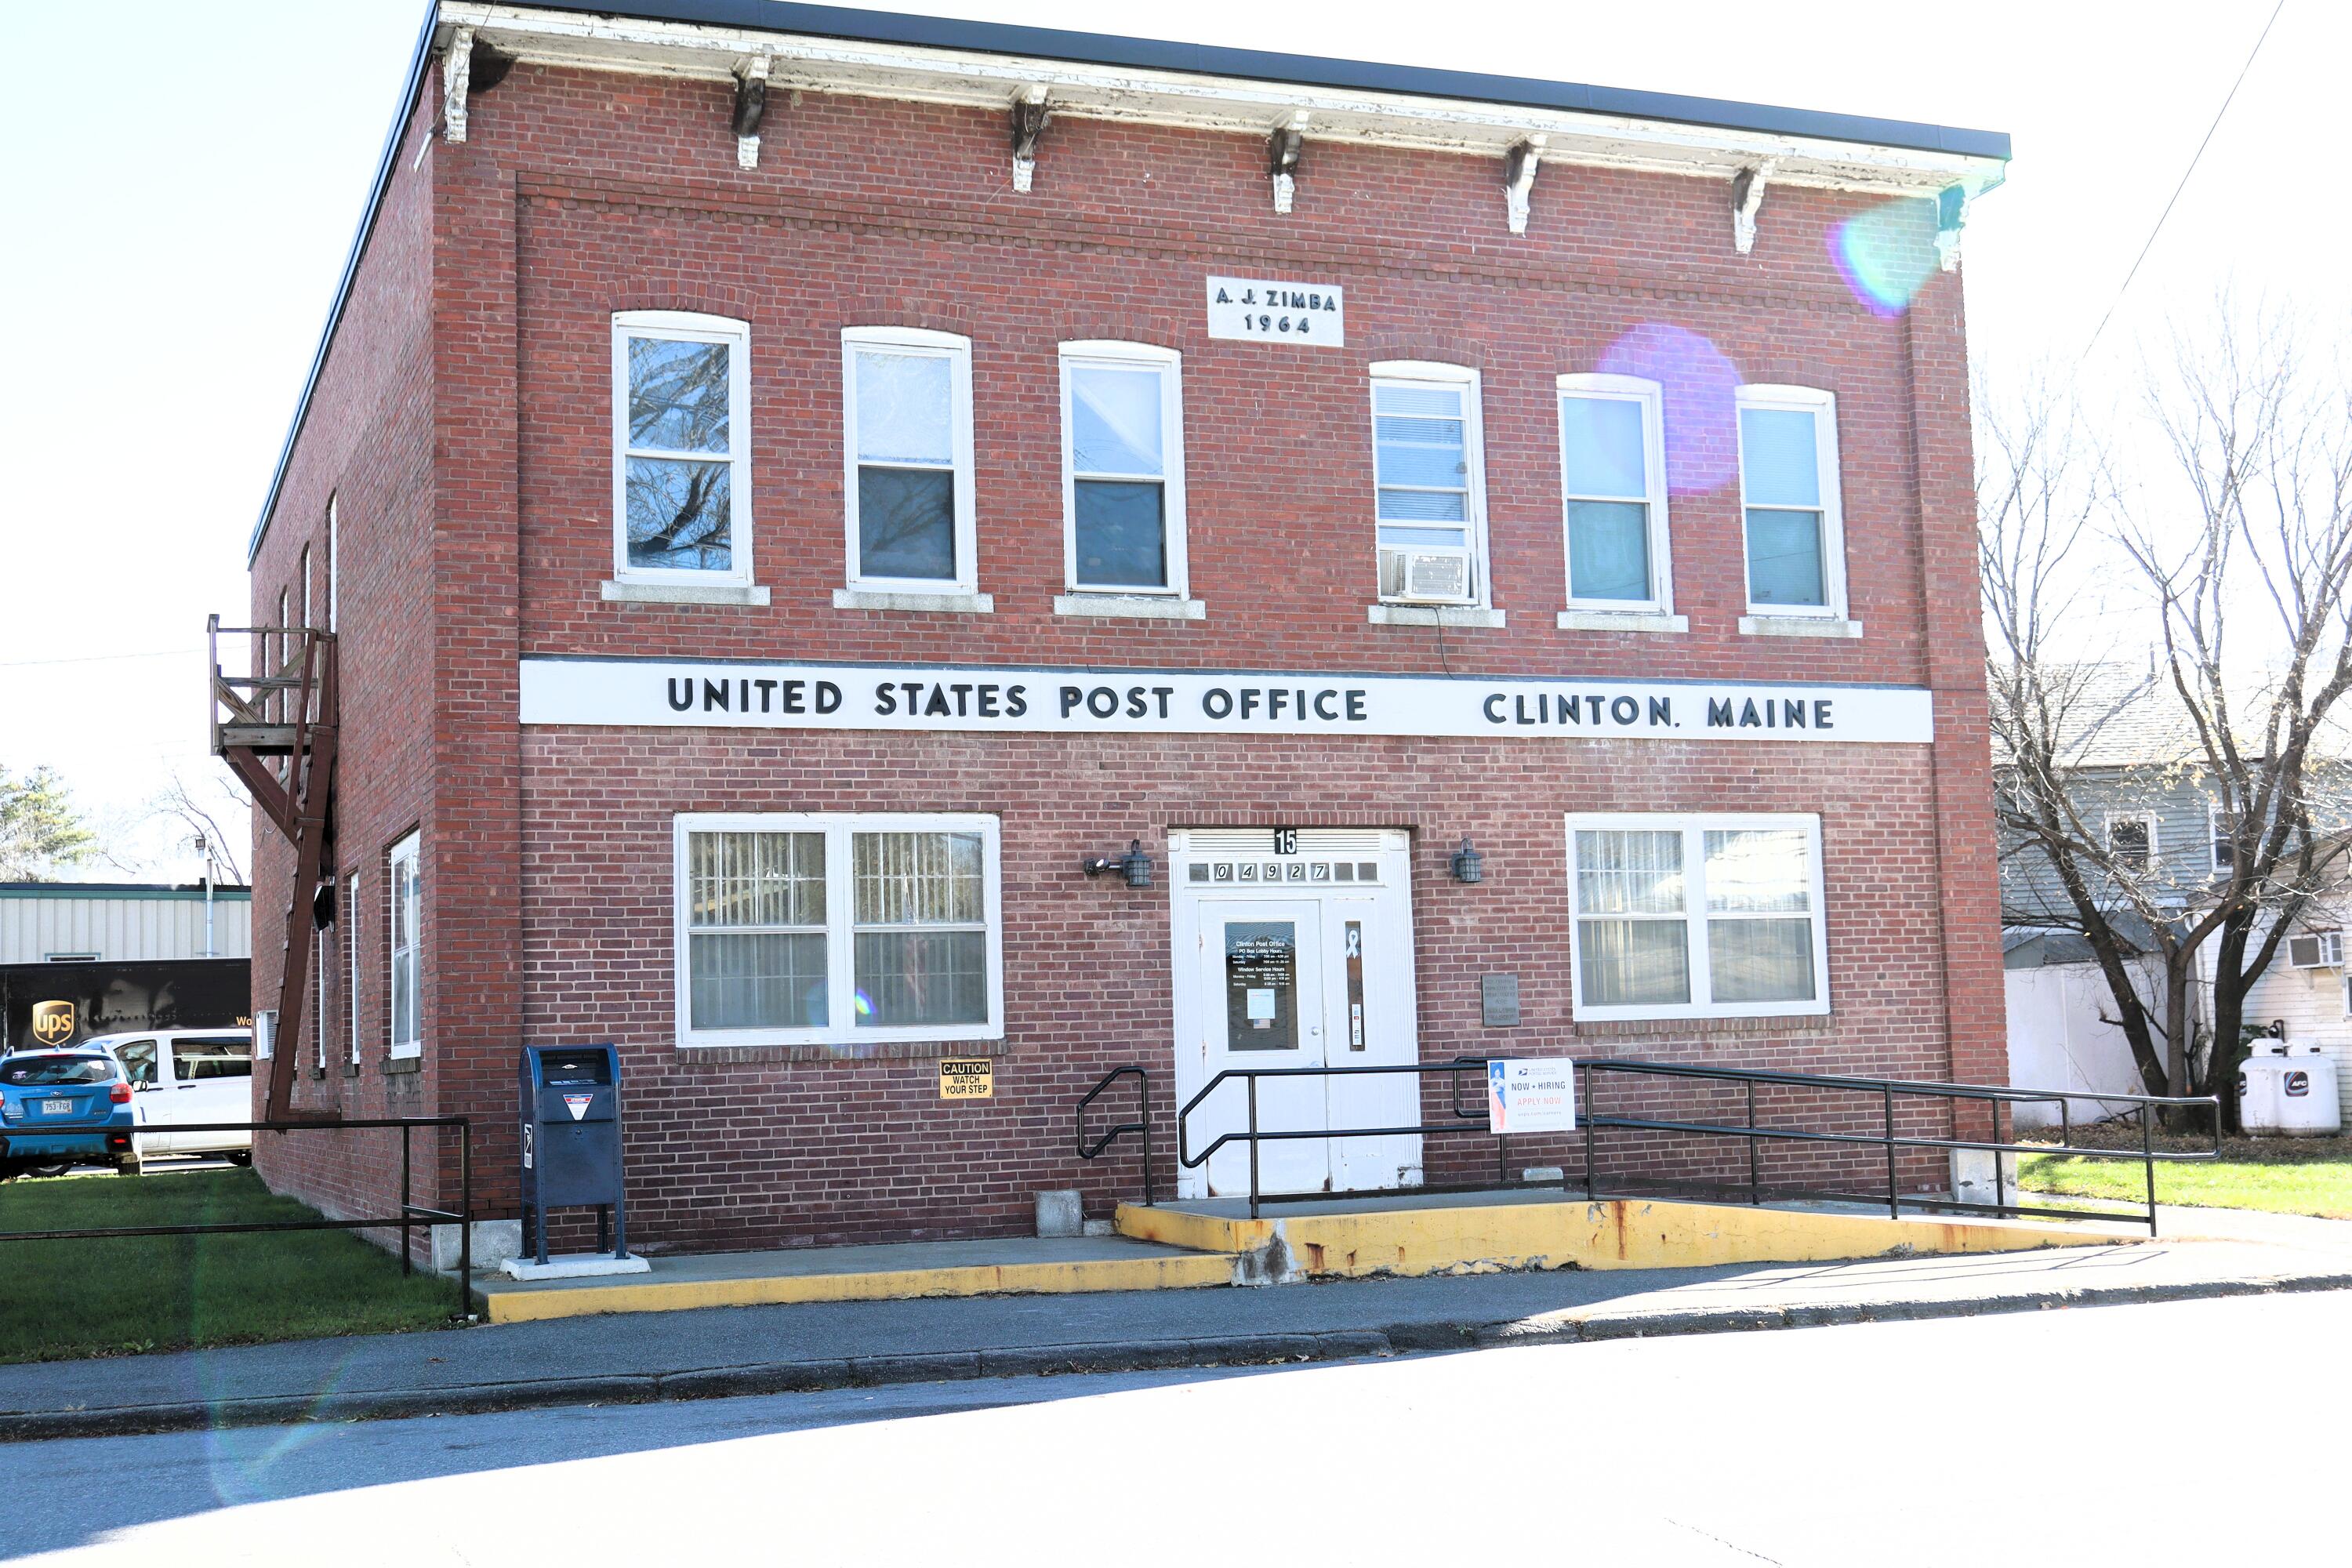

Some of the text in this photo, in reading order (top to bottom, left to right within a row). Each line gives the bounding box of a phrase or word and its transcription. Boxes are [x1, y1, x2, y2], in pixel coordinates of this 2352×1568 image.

[1216, 287, 1336, 311] A. J. ZIMBA
[1244, 314, 1310, 333] 1964
[668, 677, 842, 714] UNITED
[874, 682, 1027, 717] STATES
[1060, 687, 1174, 718] POST
[1203, 688, 1367, 721] OFFICE
[1708, 697, 1834, 729] MAINE
[1276, 829, 1297, 854] 15
[36, 1014, 71, 1039] ups
[943, 1063, 989, 1074] CAUTION
[953, 1075, 980, 1084] WATCH
[1512, 1081, 1566, 1091] NOW HIRING
[945, 1085, 987, 1094] YOUR STEP
[1517, 1097, 1540, 1106] APPLY
